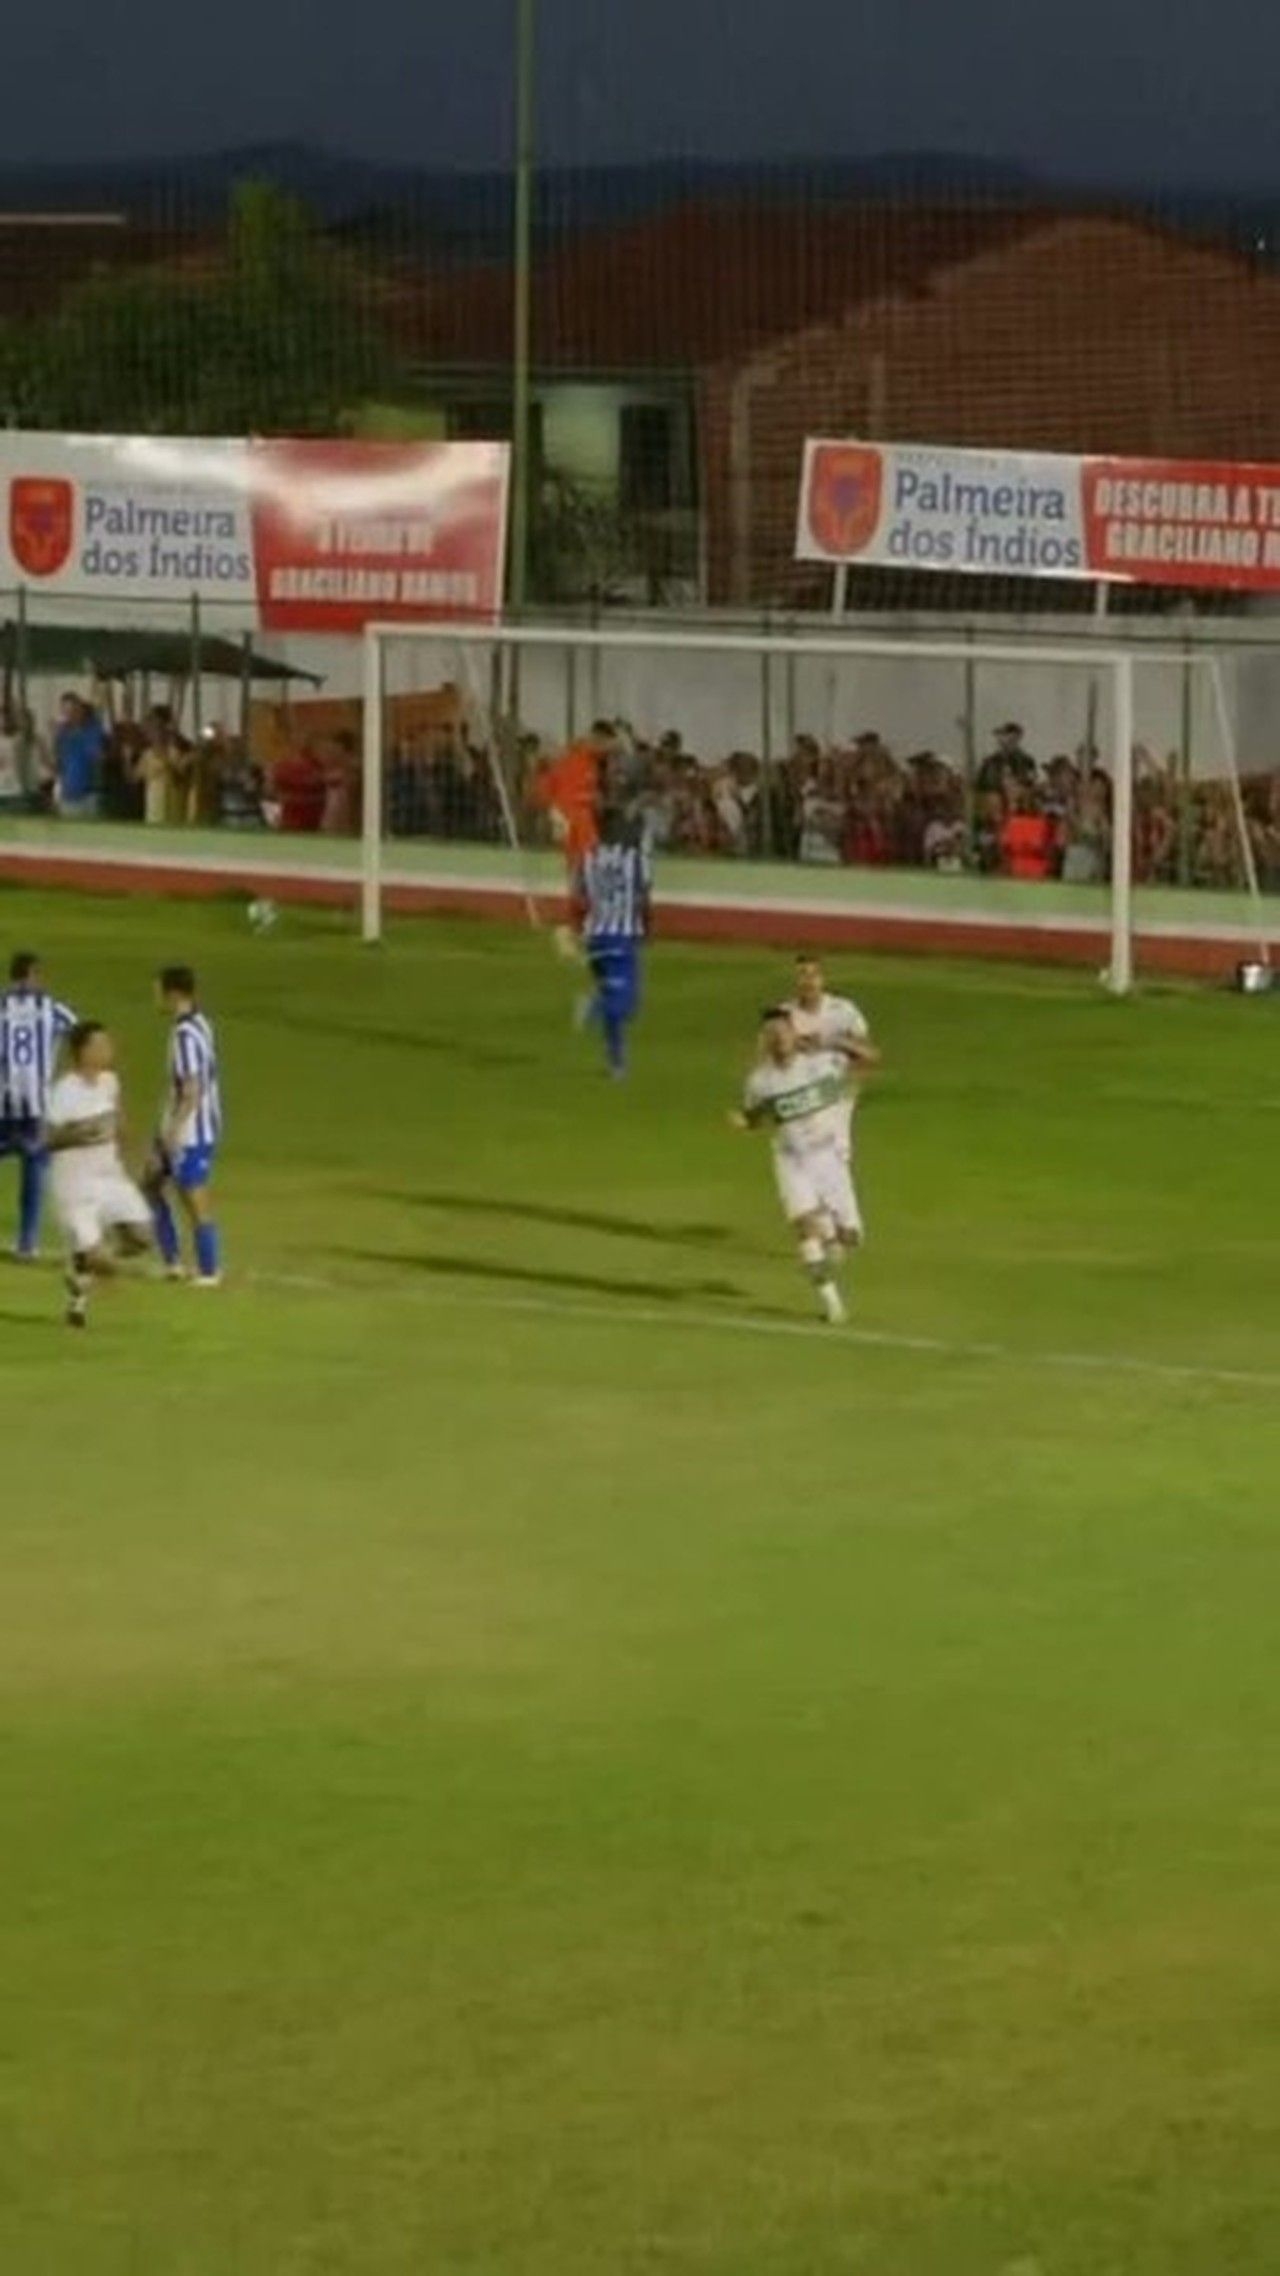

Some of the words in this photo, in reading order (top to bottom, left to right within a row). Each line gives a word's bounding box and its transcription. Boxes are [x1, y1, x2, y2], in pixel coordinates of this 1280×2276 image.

[894, 469, 1065, 519] Palmeira
[84, 498, 235, 537] Palmeira
[82, 542, 139, 577] dos
[888, 519, 955, 560] dos
[965, 519, 1081, 567] Índios
[12, 1025, 32, 1066] 8
